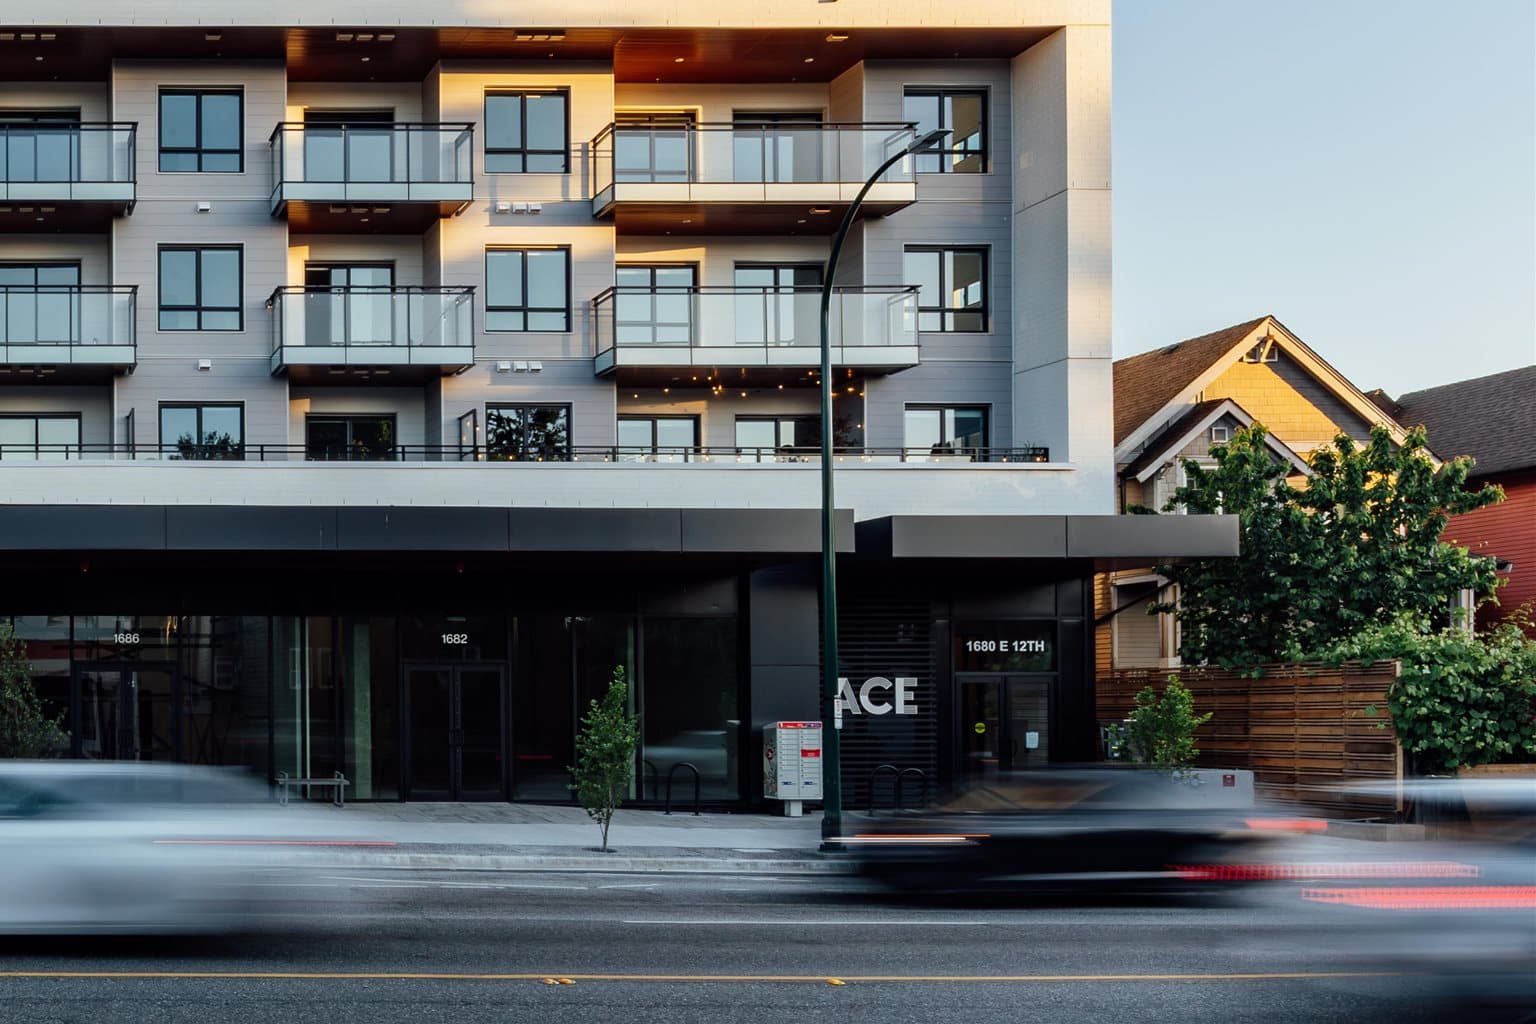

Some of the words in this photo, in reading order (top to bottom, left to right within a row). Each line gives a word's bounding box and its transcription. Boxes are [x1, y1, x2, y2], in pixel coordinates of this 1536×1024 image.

[114, 633, 140, 644] 1686
[441, 633, 468, 644] 1682
[966, 640, 996, 652] 1680
[999, 640, 1009, 652] E
[1012, 640, 1045, 652] 12TH
[837, 676, 918, 715] ACE
